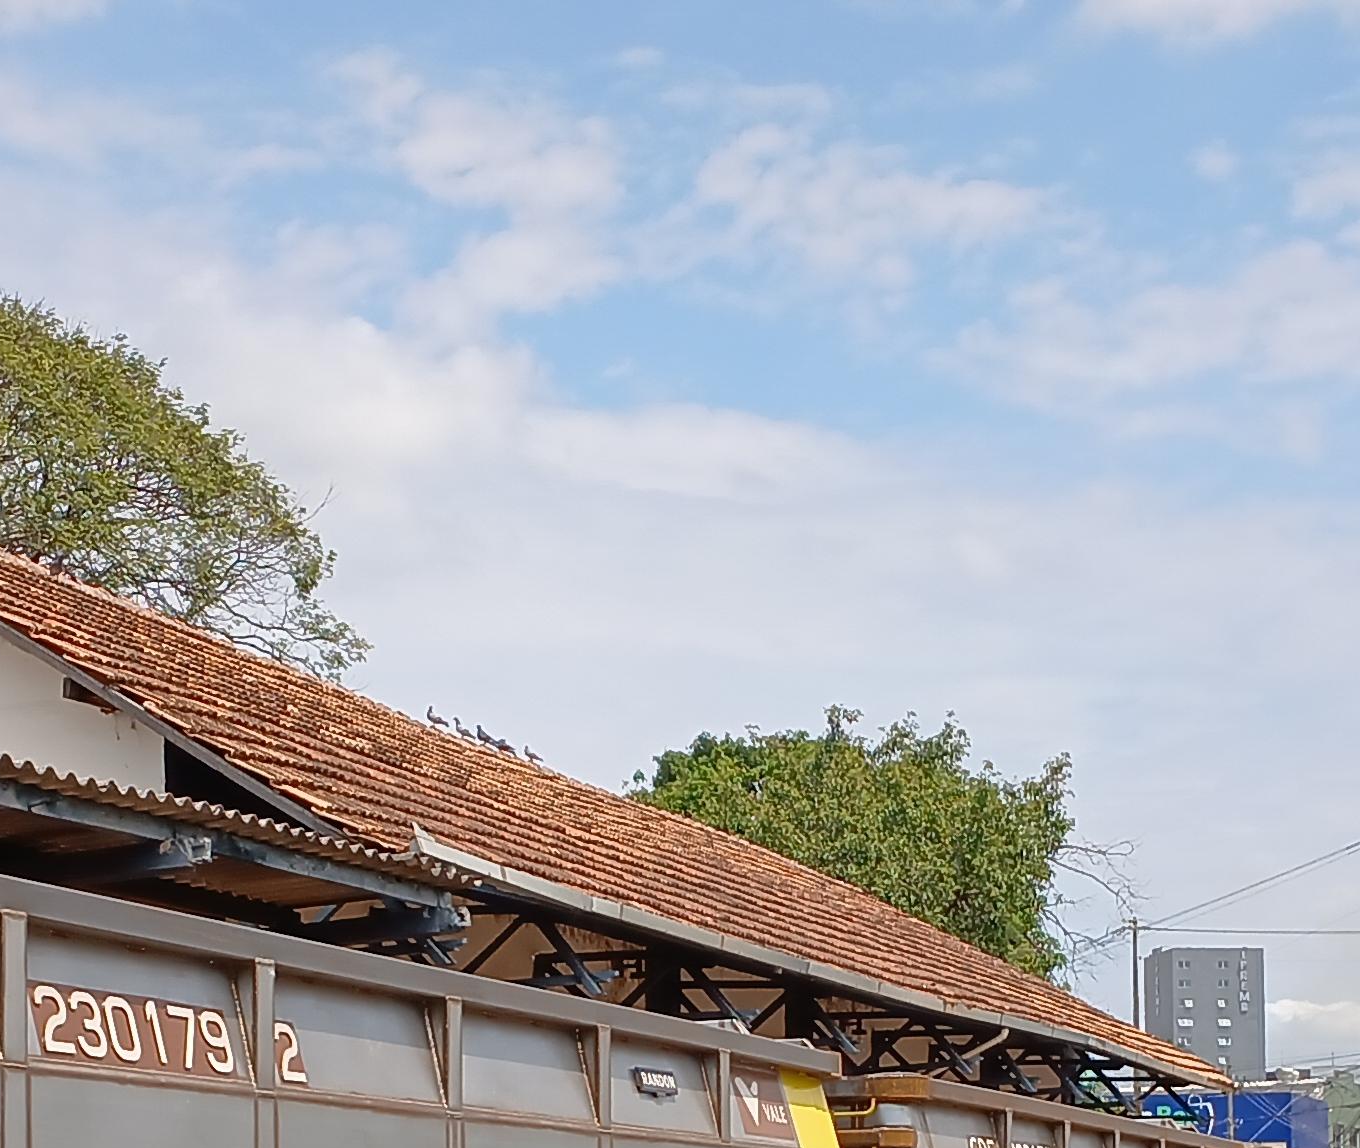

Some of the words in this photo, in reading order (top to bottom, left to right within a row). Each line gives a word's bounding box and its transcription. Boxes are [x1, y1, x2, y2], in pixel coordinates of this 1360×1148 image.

[34, 985, 234, 1073] 230179
[274, 1022, 307, 1083] 2
[761, 1103, 789, 1125] VALE
